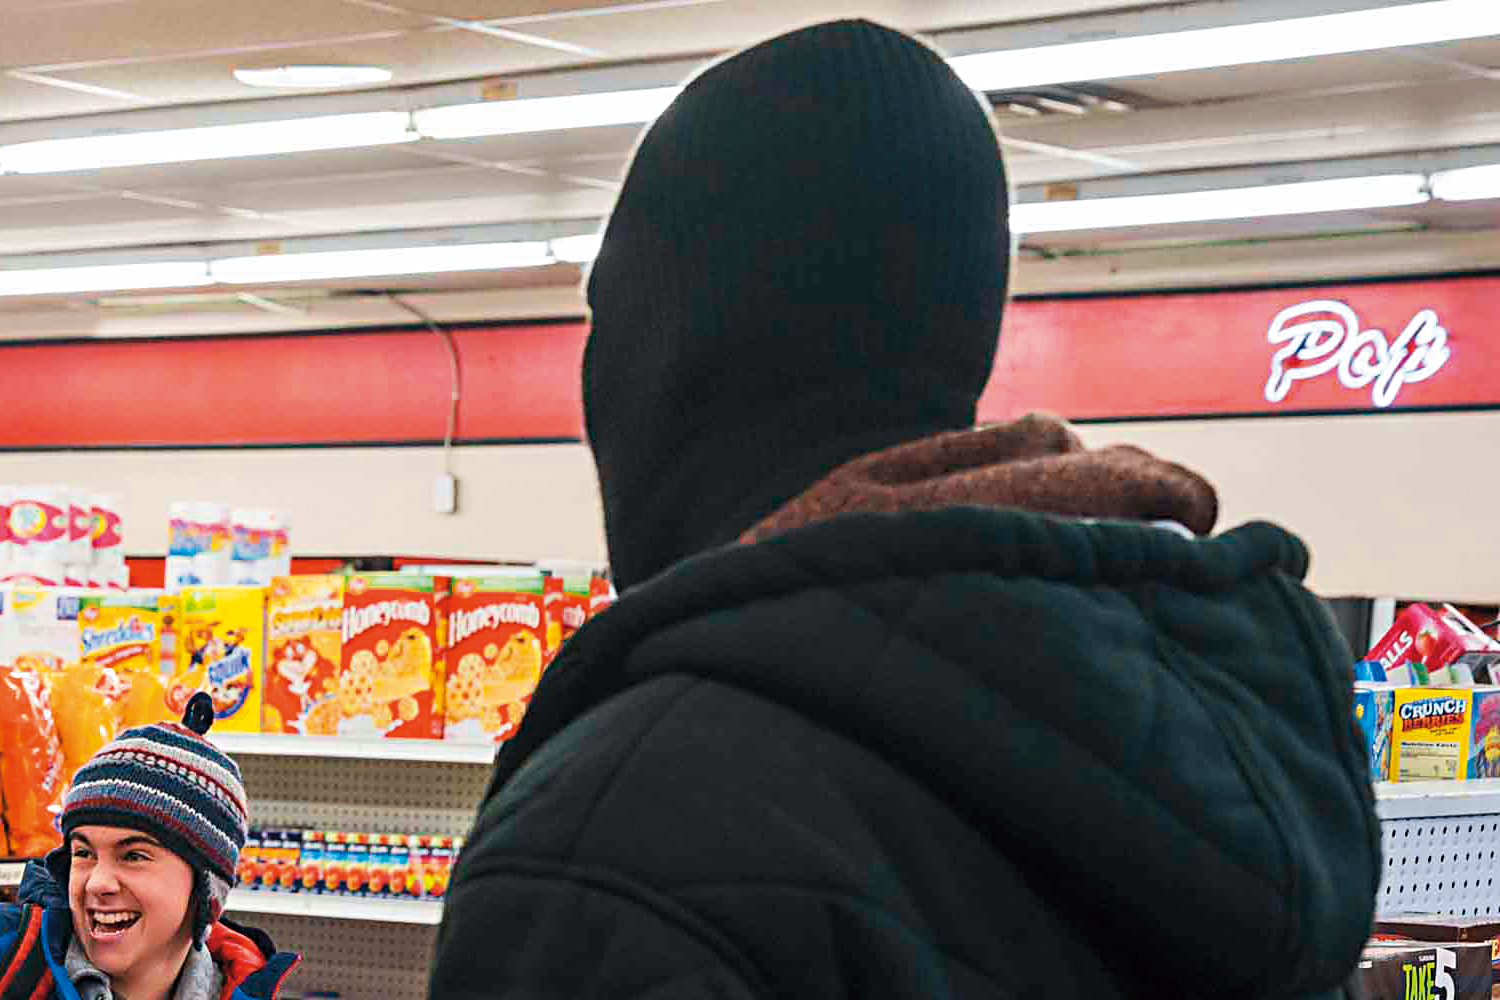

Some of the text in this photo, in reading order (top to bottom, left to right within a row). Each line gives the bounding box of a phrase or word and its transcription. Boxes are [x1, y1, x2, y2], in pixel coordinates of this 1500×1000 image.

[1264, 299, 1450, 408] Pop
[343, 599, 431, 643] Honeycomb
[448, 600, 541, 648] Honeycomb
[1378, 630, 1413, 669] ALLS
[1400, 697, 1467, 721] CRUNCH
